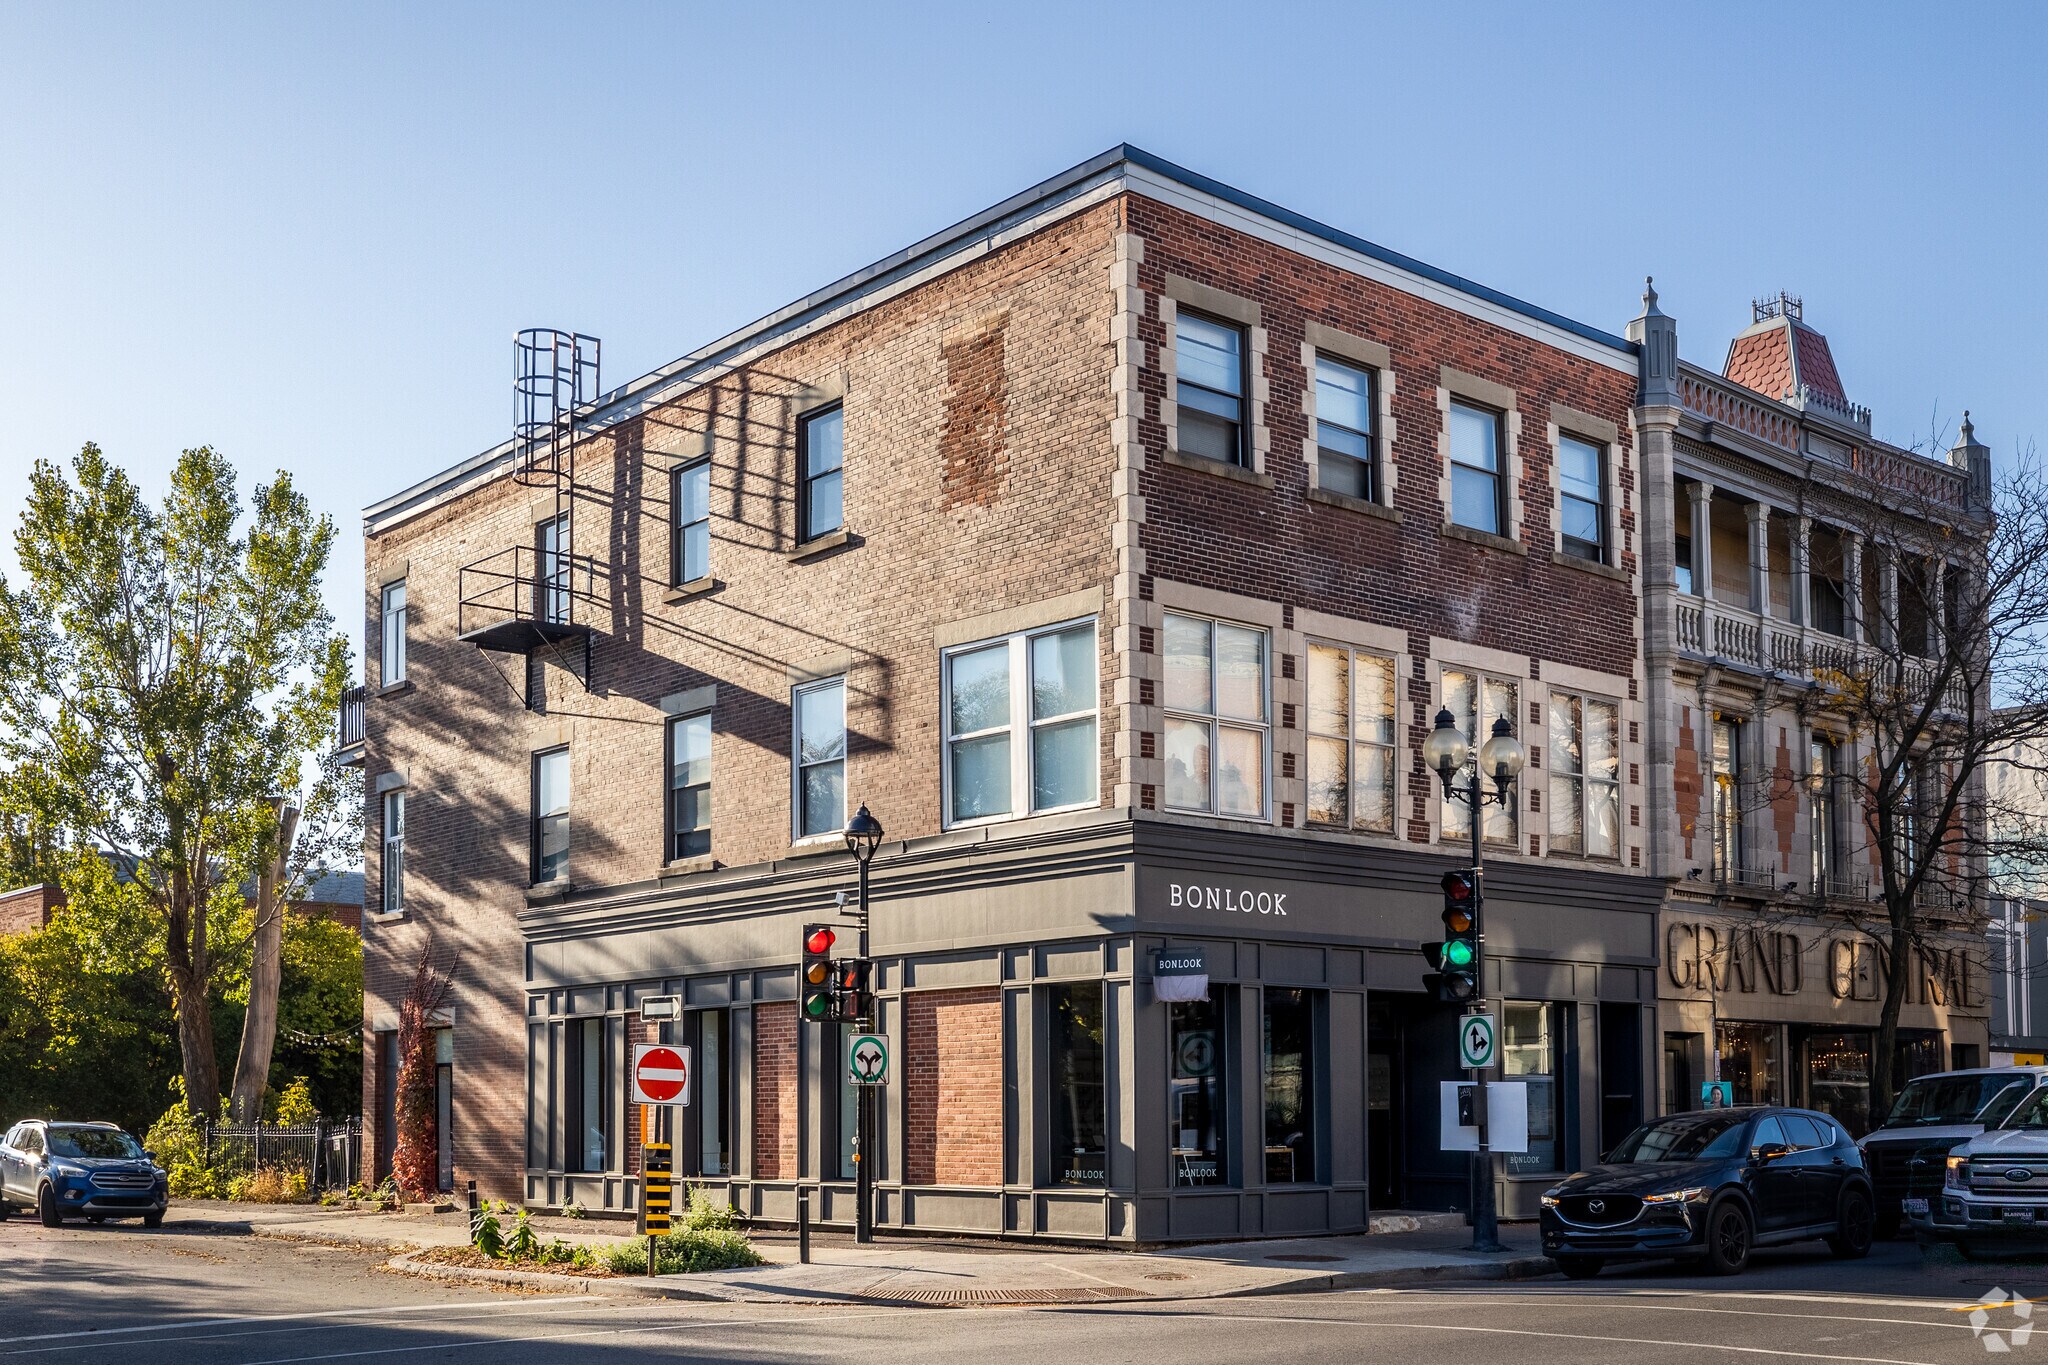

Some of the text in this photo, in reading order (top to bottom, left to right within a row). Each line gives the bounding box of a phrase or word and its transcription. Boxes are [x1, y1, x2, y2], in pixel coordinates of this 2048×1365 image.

[1169, 883, 1287, 916] BONLOOK
[1159, 958, 1202, 970] BONLOOK
[1667, 921, 1804, 996] GRAND
[1510, 1156, 1540, 1164] BONLOOK
[1065, 1169, 1105, 1180] BONLOOK
[1179, 1168, 1217, 1179] BONLOOK
